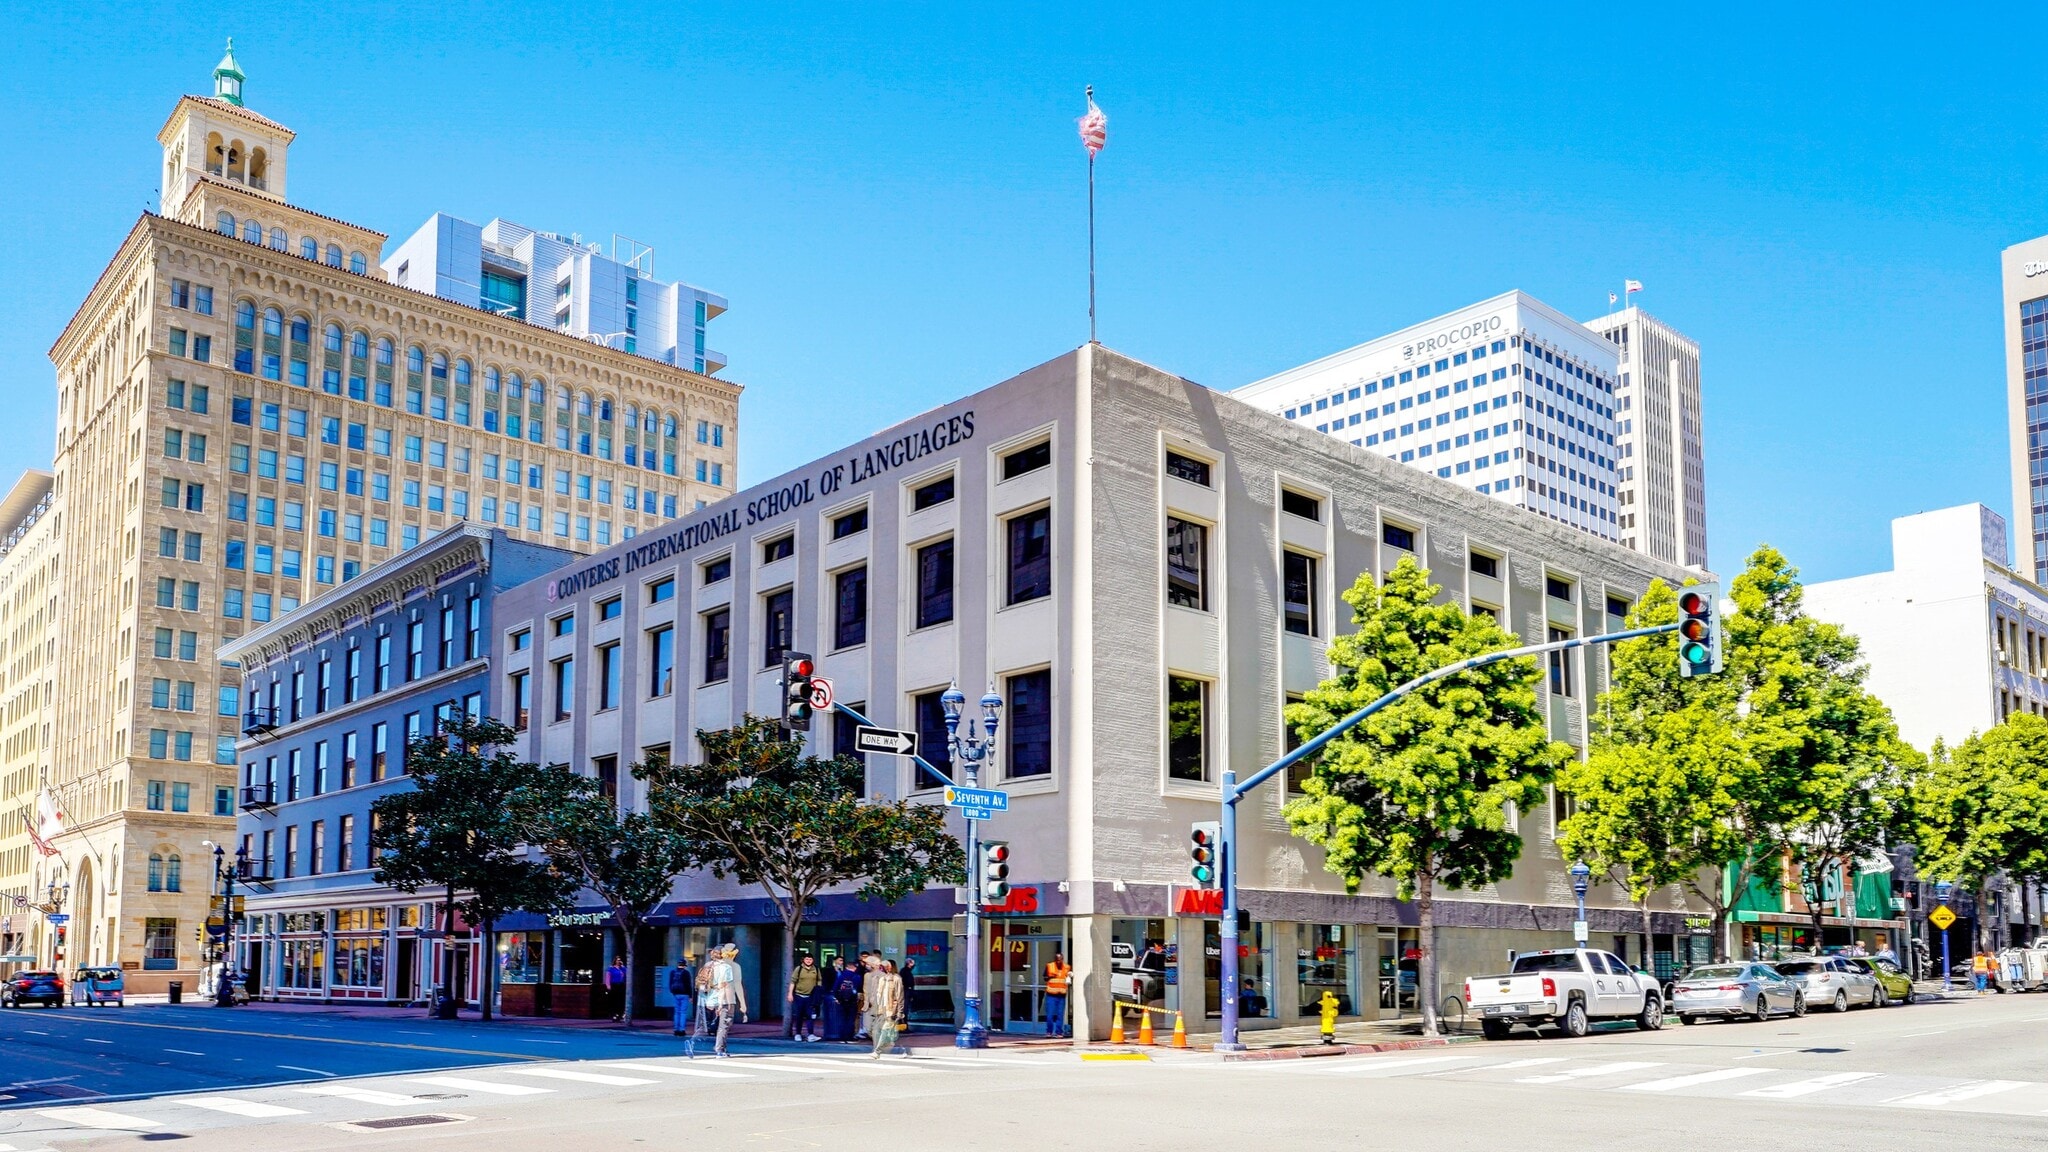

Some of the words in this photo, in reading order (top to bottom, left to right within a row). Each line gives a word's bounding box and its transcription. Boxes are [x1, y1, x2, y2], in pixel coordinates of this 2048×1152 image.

[1416, 315, 1502, 356] PROCOPIO
[558, 556, 621, 600] CONVERSE
[625, 508, 742, 574] INTERNATIONAL
[746, 478, 815, 525] SCHOOL
[820, 464, 845, 496] OF
[850, 411, 975, 485] LANGUAGES
[865, 735, 881, 745] ONE
[883, 737, 899, 747] WAY
[1113, 945, 1130, 955] Uber
[1205, 946, 1221, 956] Uber
